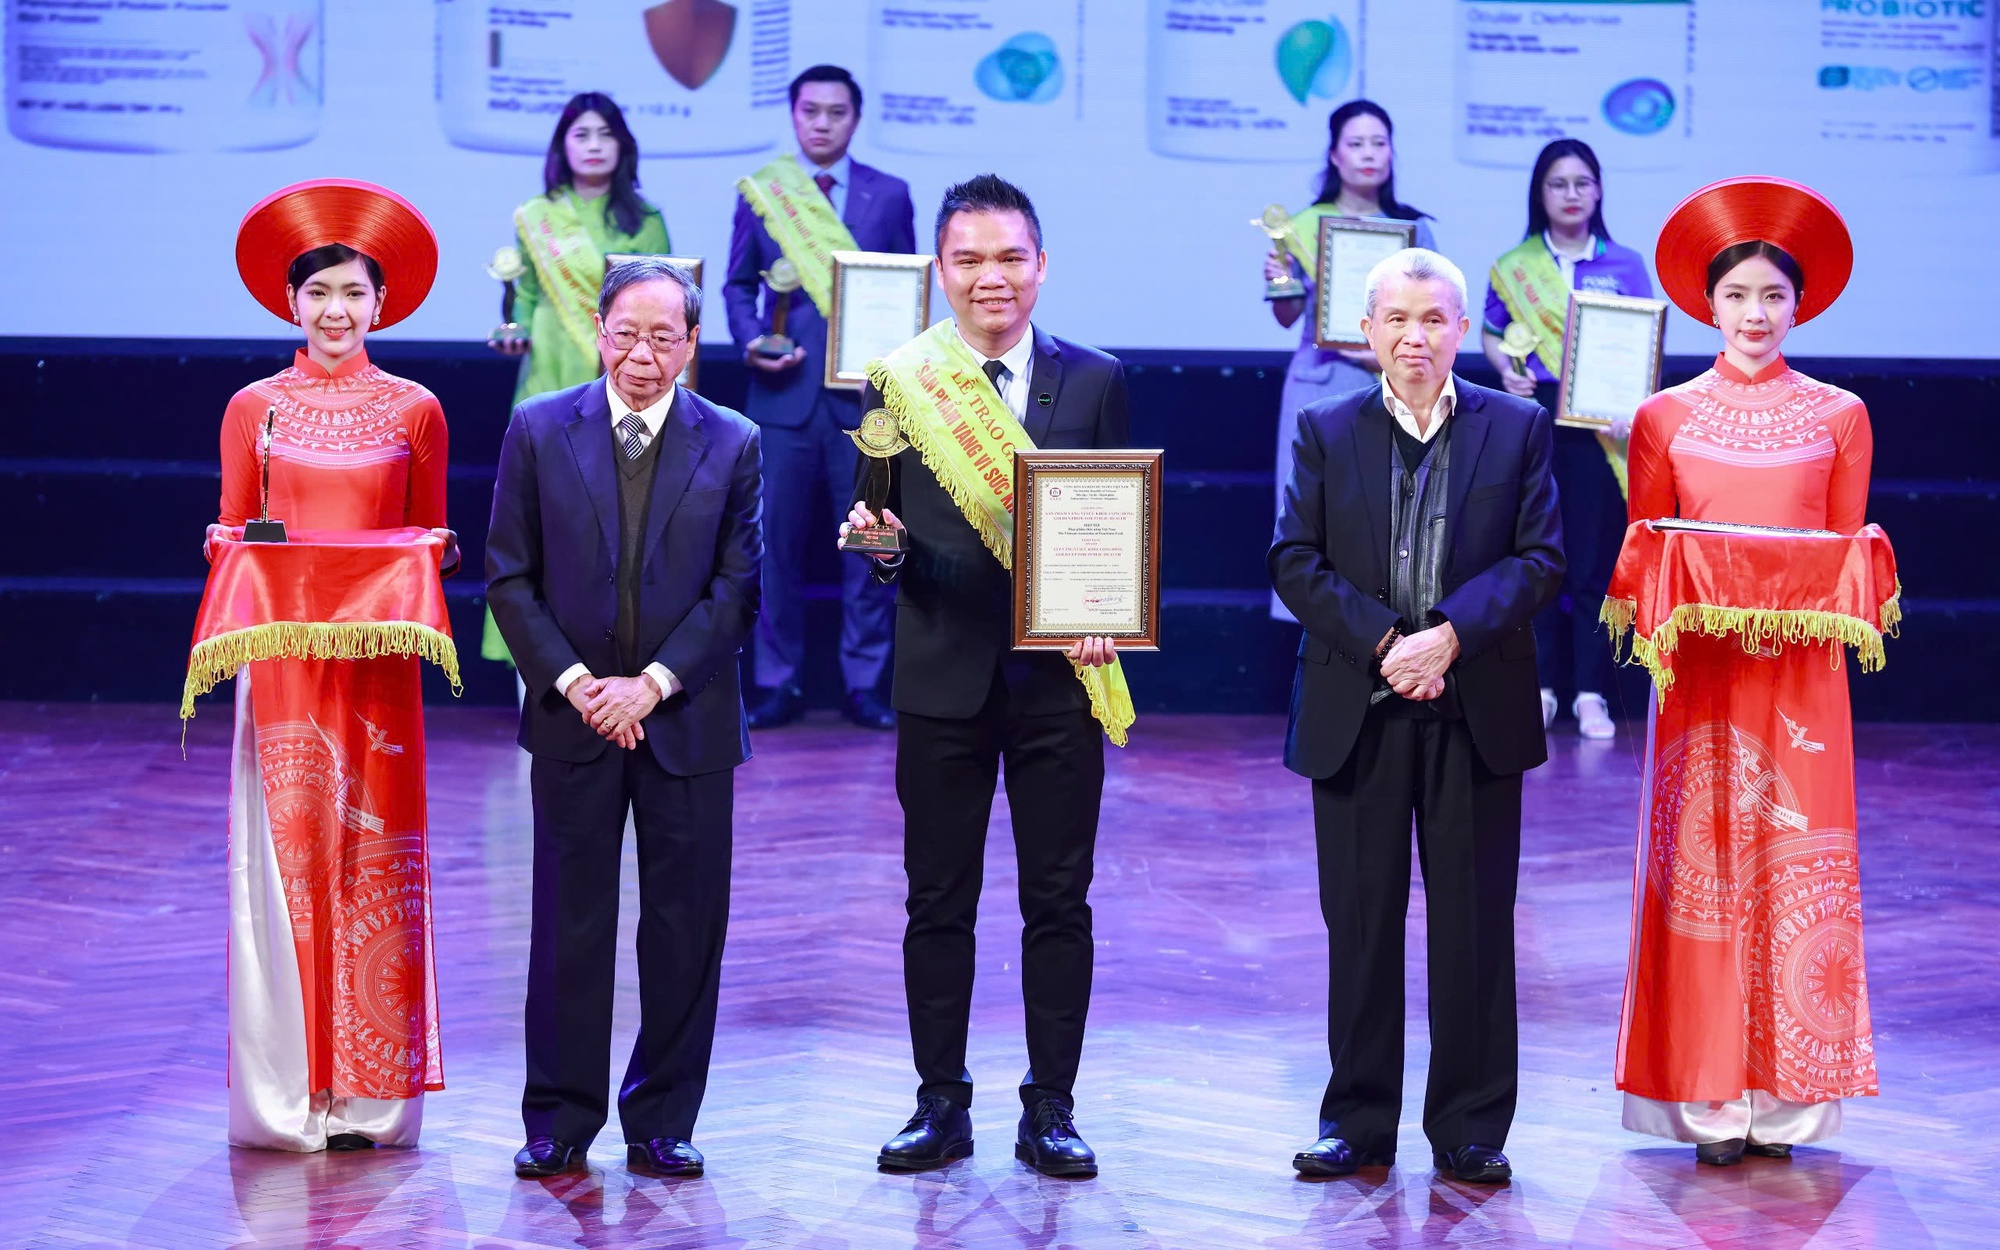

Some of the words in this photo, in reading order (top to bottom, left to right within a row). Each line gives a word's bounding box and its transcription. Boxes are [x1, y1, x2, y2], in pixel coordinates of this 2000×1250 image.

[931, 388, 962, 426] PHẨM
[951, 369, 980, 395] LỄ
[969, 393, 1005, 441] TRAO
[952, 421, 983, 458] VÀNG
[974, 453, 996, 472] VÌ
[983, 467, 1010, 495] SỨC
